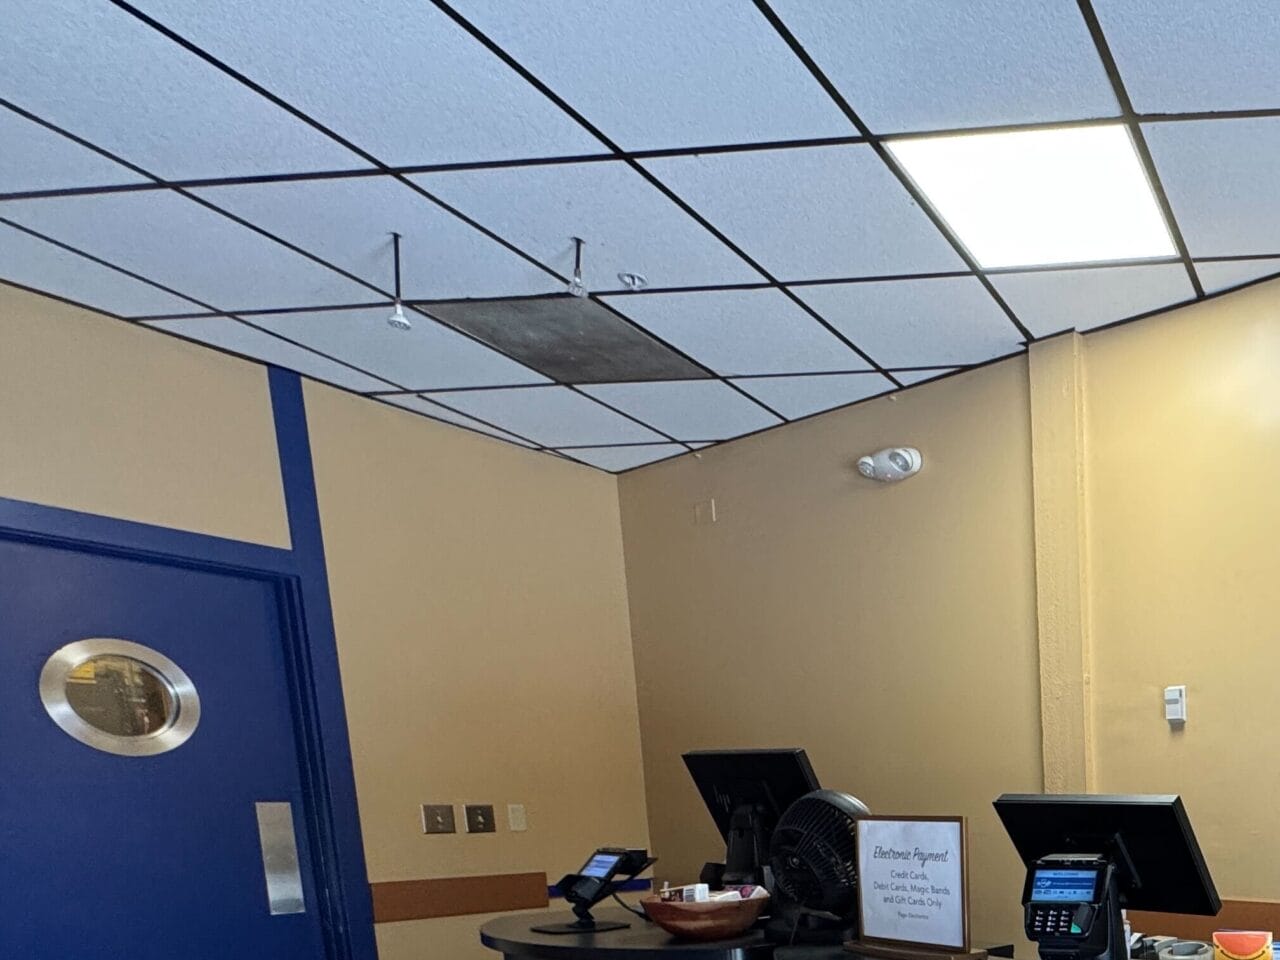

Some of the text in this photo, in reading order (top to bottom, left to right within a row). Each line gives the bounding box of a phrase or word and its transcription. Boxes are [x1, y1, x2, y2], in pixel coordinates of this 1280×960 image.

[873, 846, 949, 868] Electronic Payment
[890, 870, 909, 880] Credit
[873, 881, 890, 890] Debit
[910, 884, 930, 895] Magic
[930, 885, 951, 895] Bands
[927, 898, 942, 910] Only
